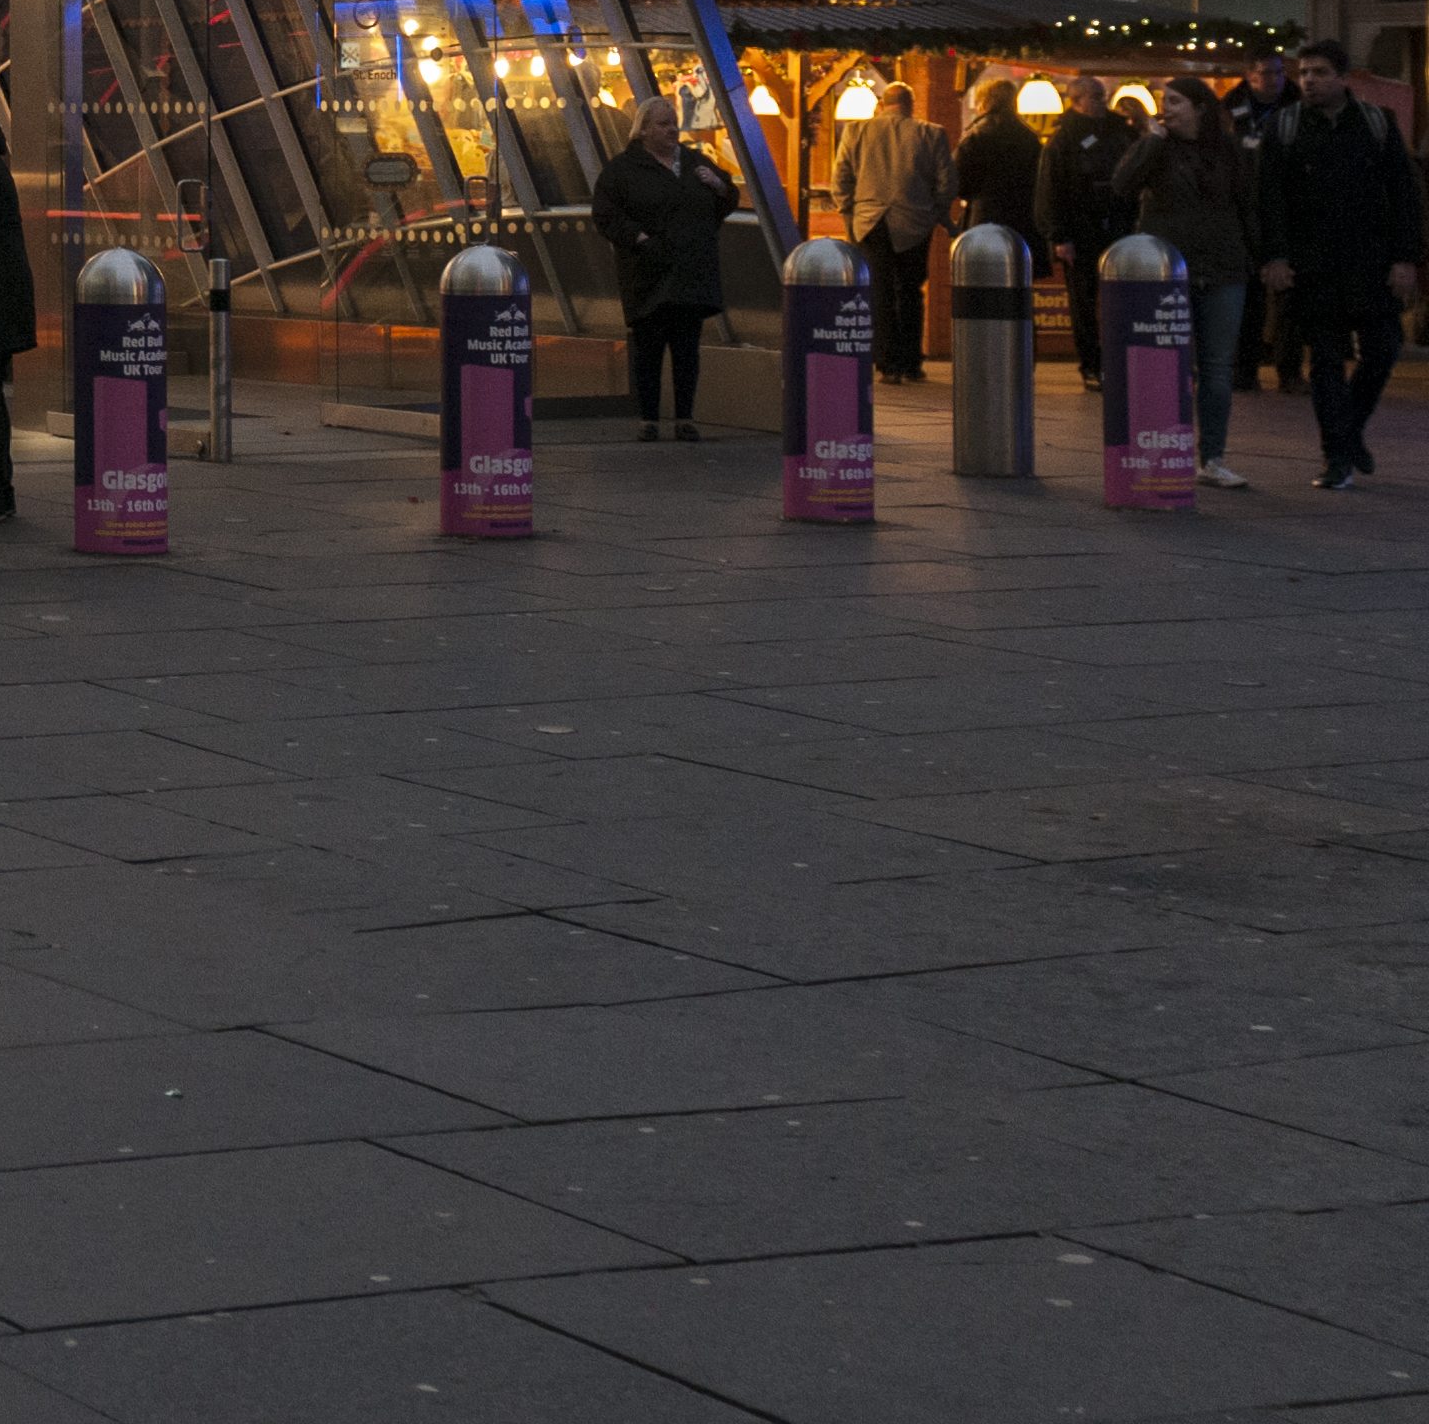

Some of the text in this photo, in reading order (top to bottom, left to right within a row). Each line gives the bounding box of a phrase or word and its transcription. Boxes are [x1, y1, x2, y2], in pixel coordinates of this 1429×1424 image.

[368, 69, 396, 80] Enoch
[122, 336, 145, 348] Red
[467, 339, 502, 351] Music
[100, 350, 136, 362] Music
[490, 353, 508, 364] UK
[123, 364, 141, 376] UK
[87, 499, 115, 512] 13th
[127, 500, 154, 512] 16th
